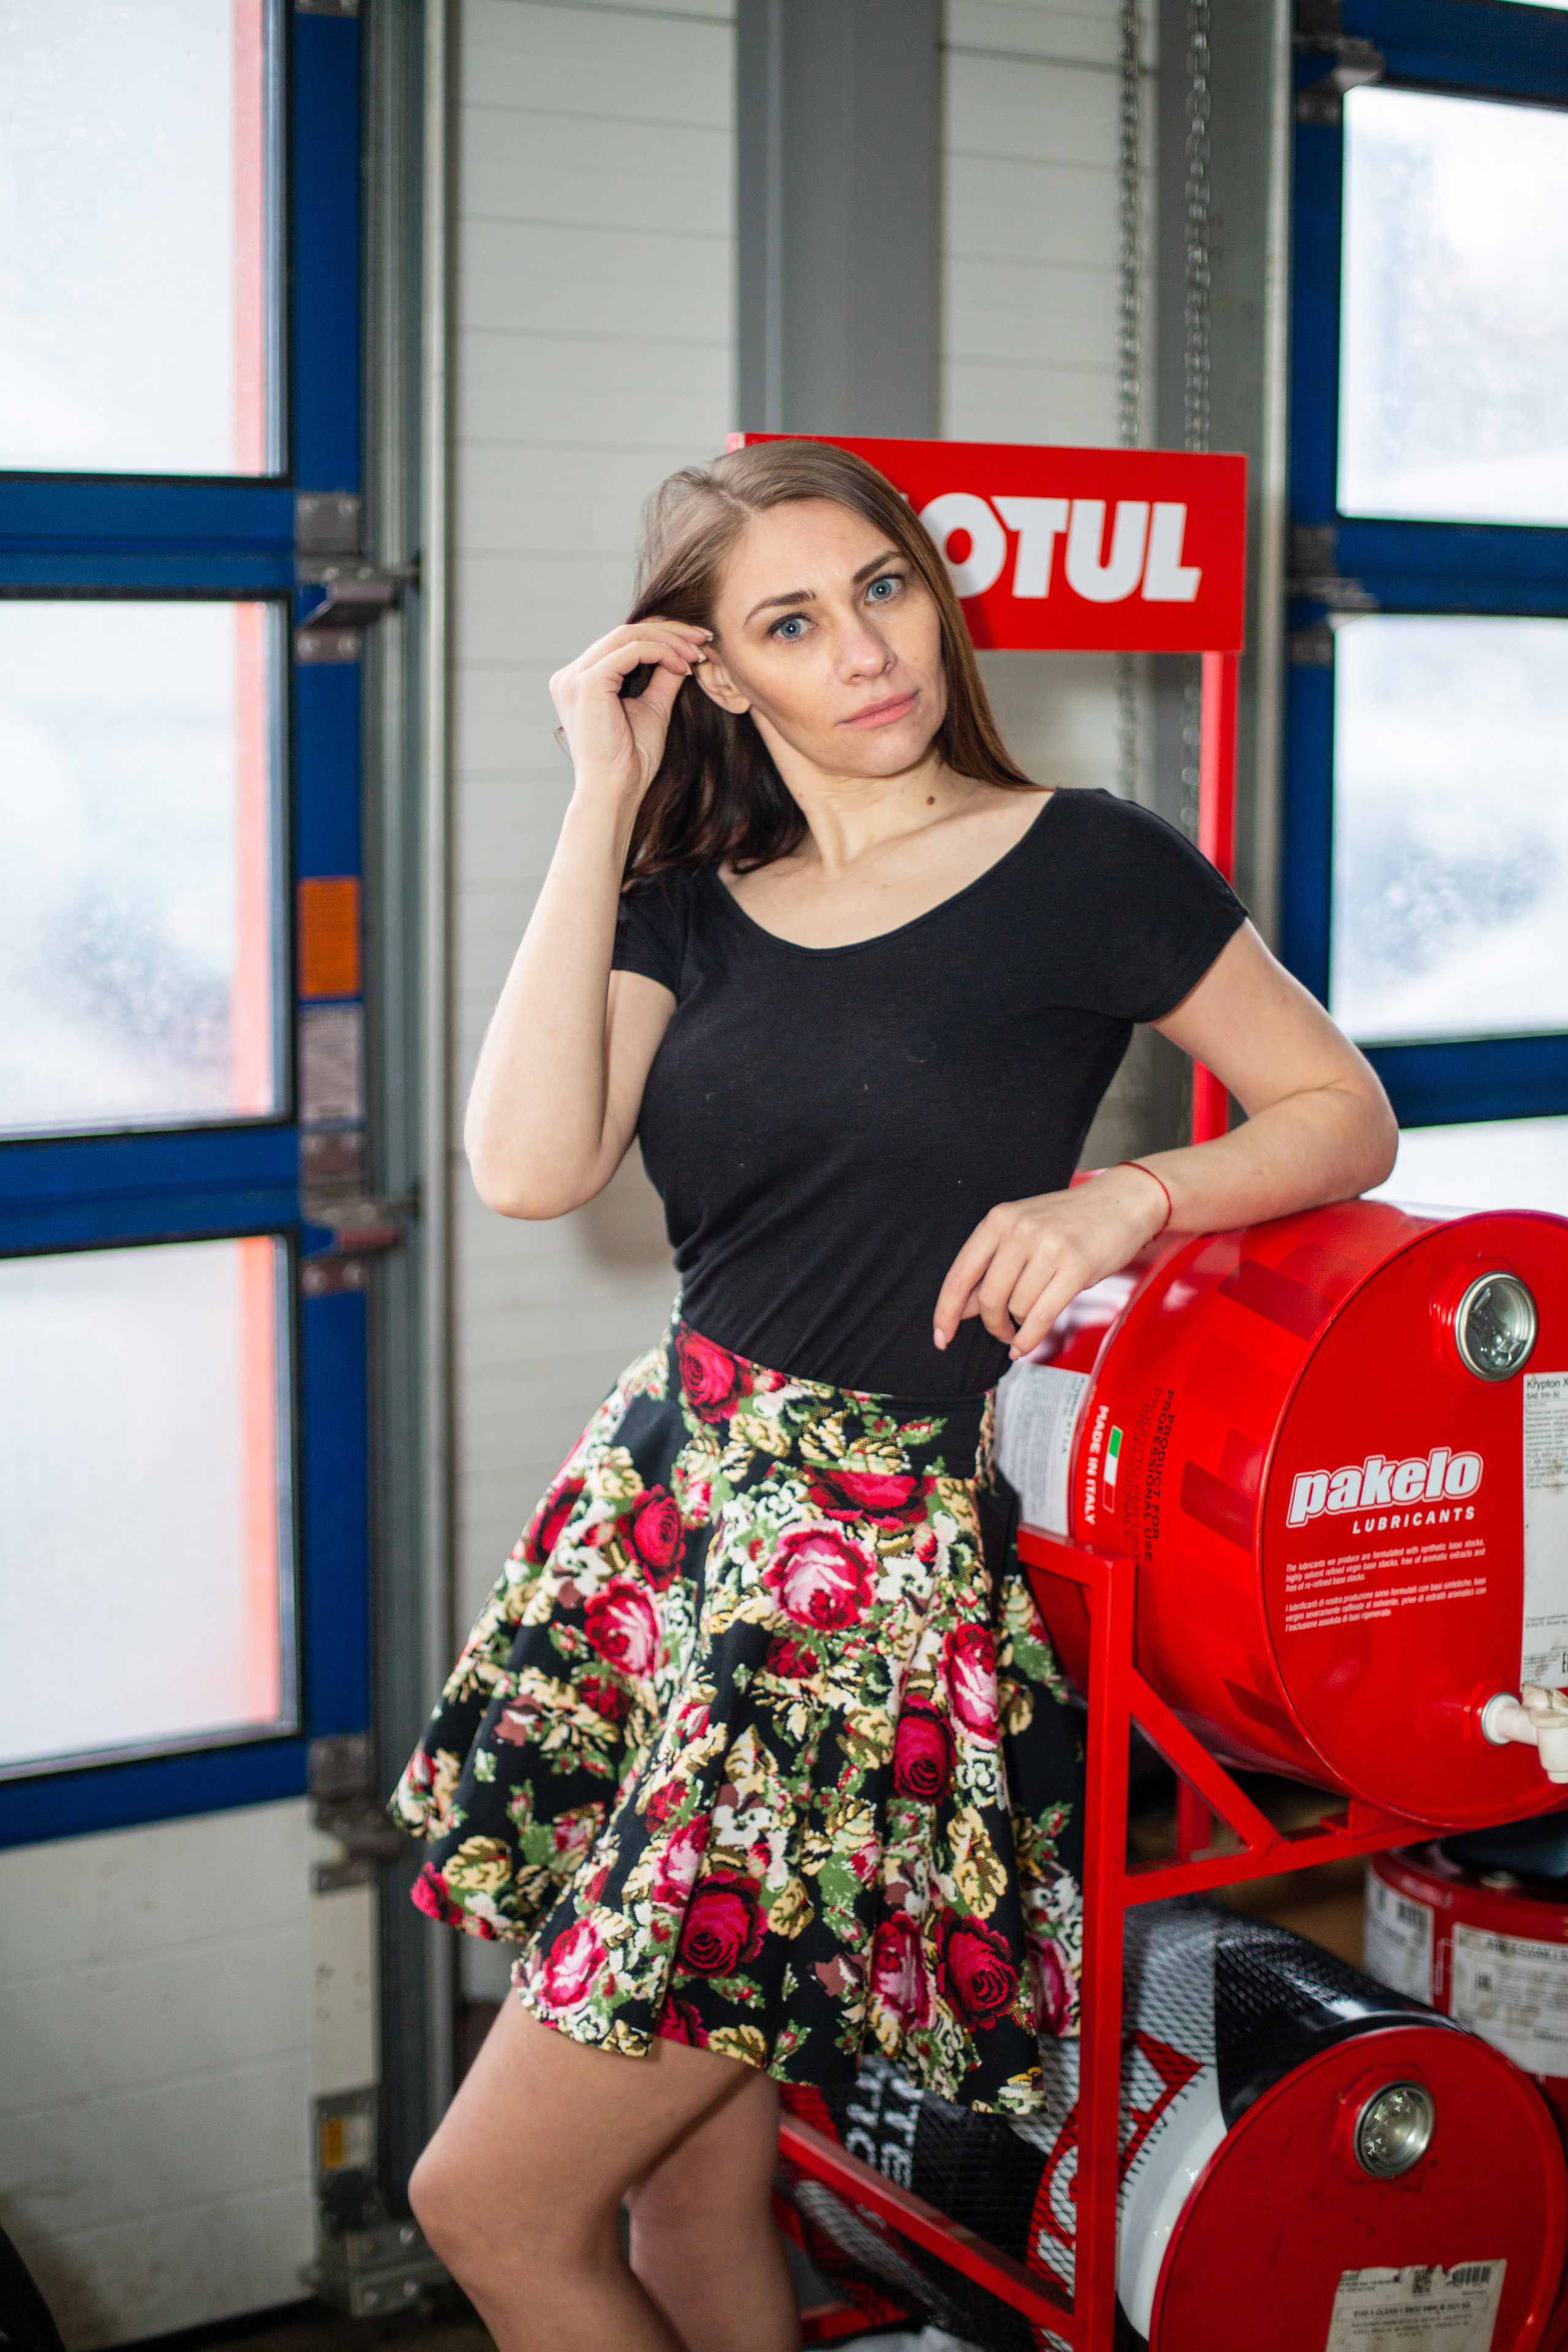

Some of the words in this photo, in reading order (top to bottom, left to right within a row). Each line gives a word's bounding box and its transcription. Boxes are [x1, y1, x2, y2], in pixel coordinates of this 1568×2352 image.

[903, 492, 1202, 603] OTUL
[1526, 1379, 1561, 1391] Krypton
[1088, 1405, 1109, 1455] MADE
[1133, 1387, 1162, 1479] PRODOTTO
[1086, 1457, 1099, 1477] IN
[1122, 1403, 1148, 1539] PROFESSIONALE
[1144, 1389, 1175, 1521] PROFESSIONAL
[1153, 1414, 1175, 1500] PRODUCT
[1084, 1478, 1097, 1525] ITALY
[1131, 1485, 1140, 1523] PER
[1286, 1446, 1483, 1529] pakelo
[1151, 1504, 1160, 1540] FOR
[1352, 1506, 1475, 1534] LUBRICANTS
[1130, 1526, 1140, 1559] USO
[1144, 1528, 1153, 1562] USE
[1298, 1560, 1325, 1570] lubricants
